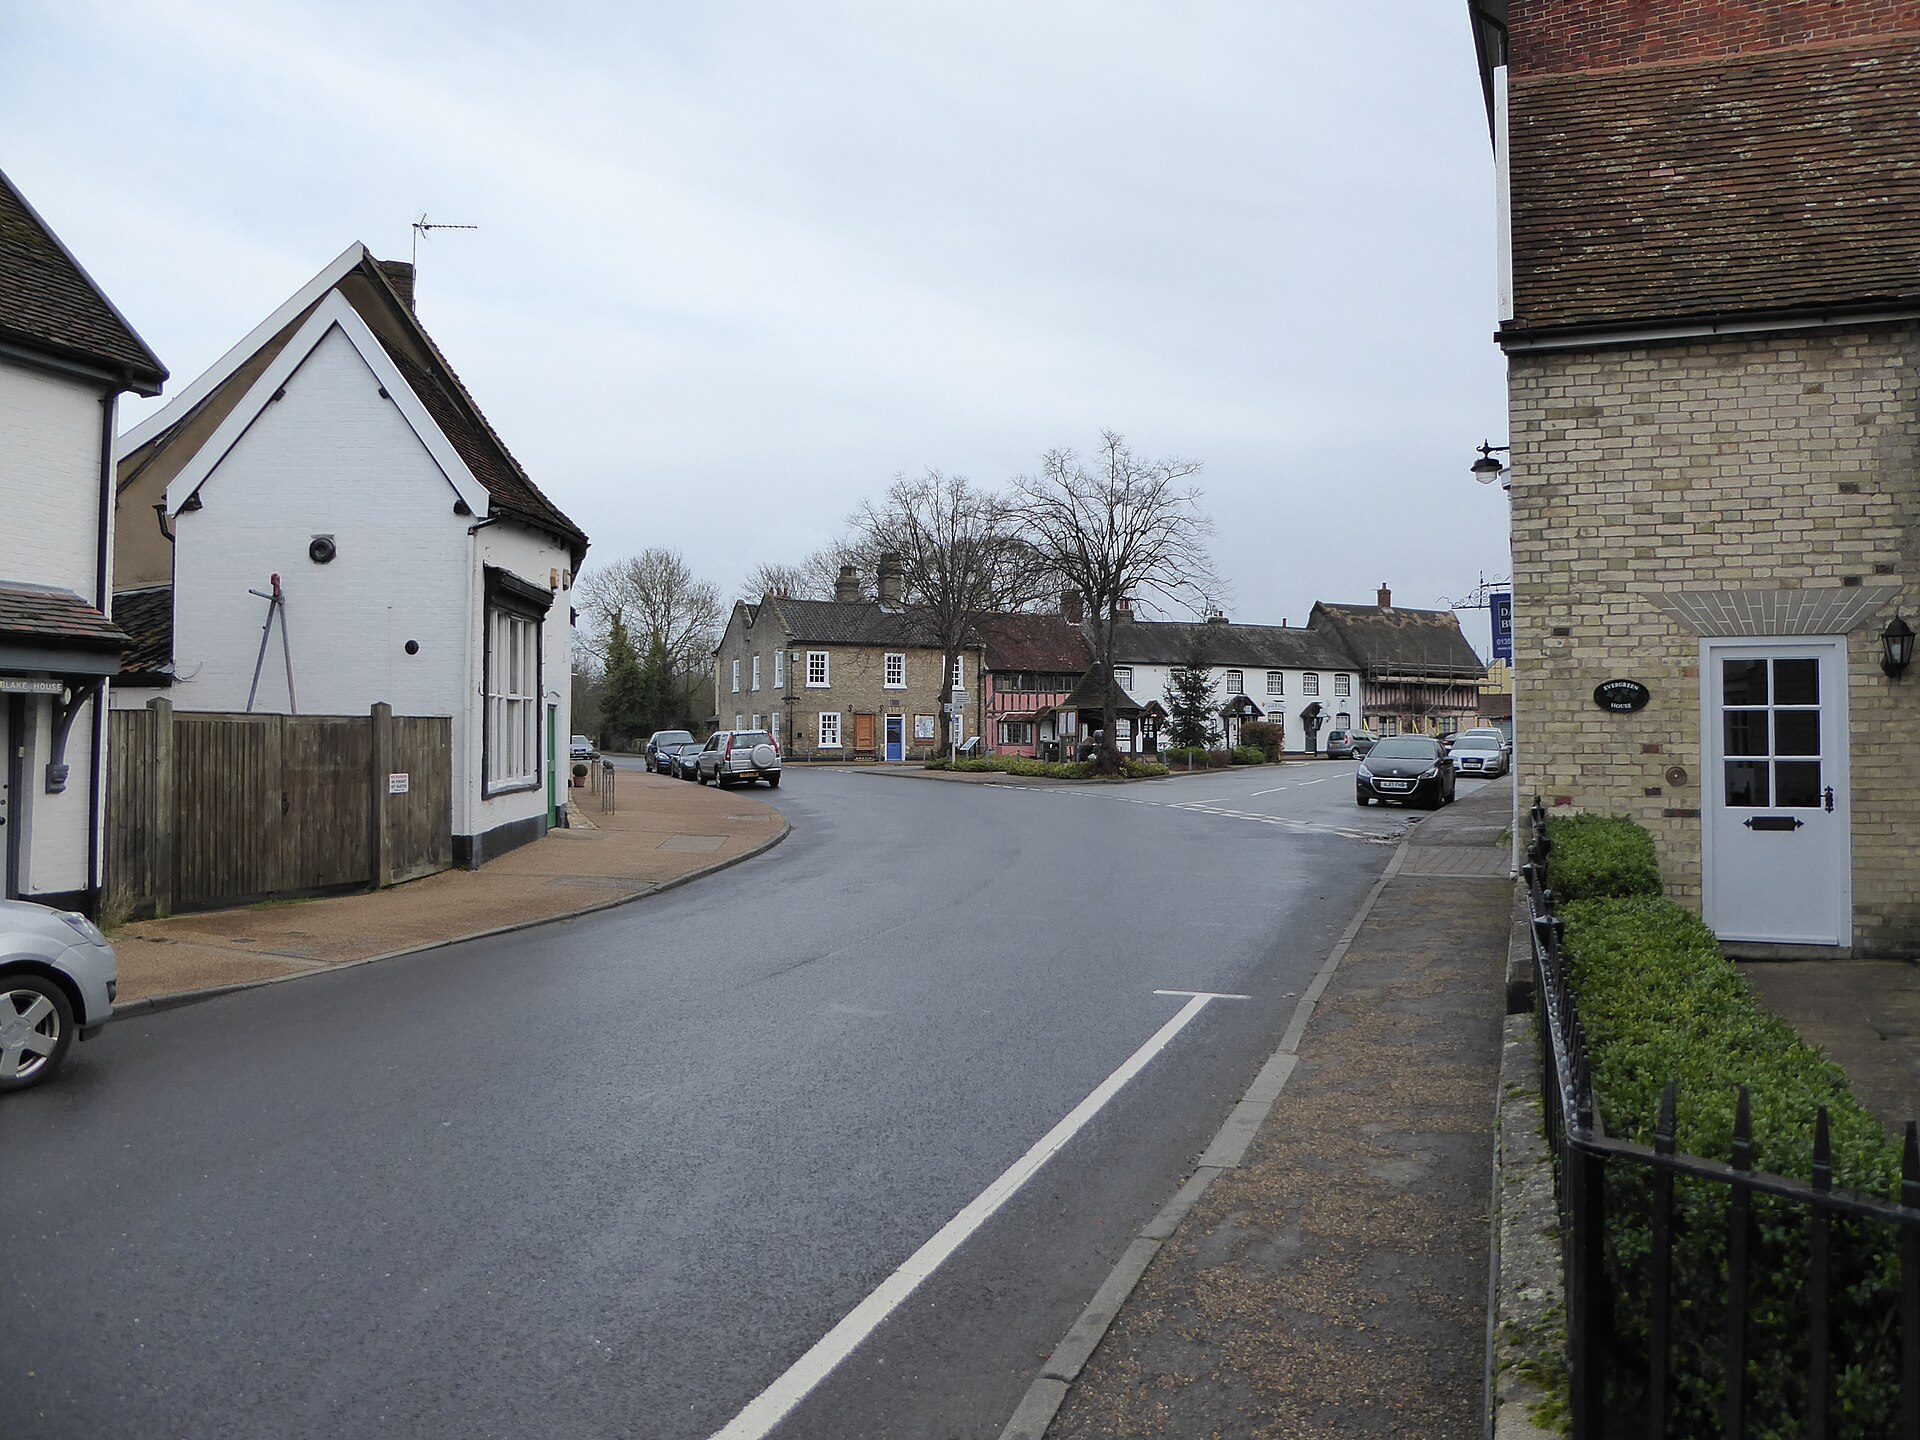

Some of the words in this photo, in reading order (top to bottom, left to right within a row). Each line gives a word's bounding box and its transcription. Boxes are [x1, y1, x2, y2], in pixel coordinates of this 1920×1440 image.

[0, 680, 28, 690] BLAKE
[33, 682, 63, 691] HOUSE
[1603, 682, 1639, 691] EVERGREEN
